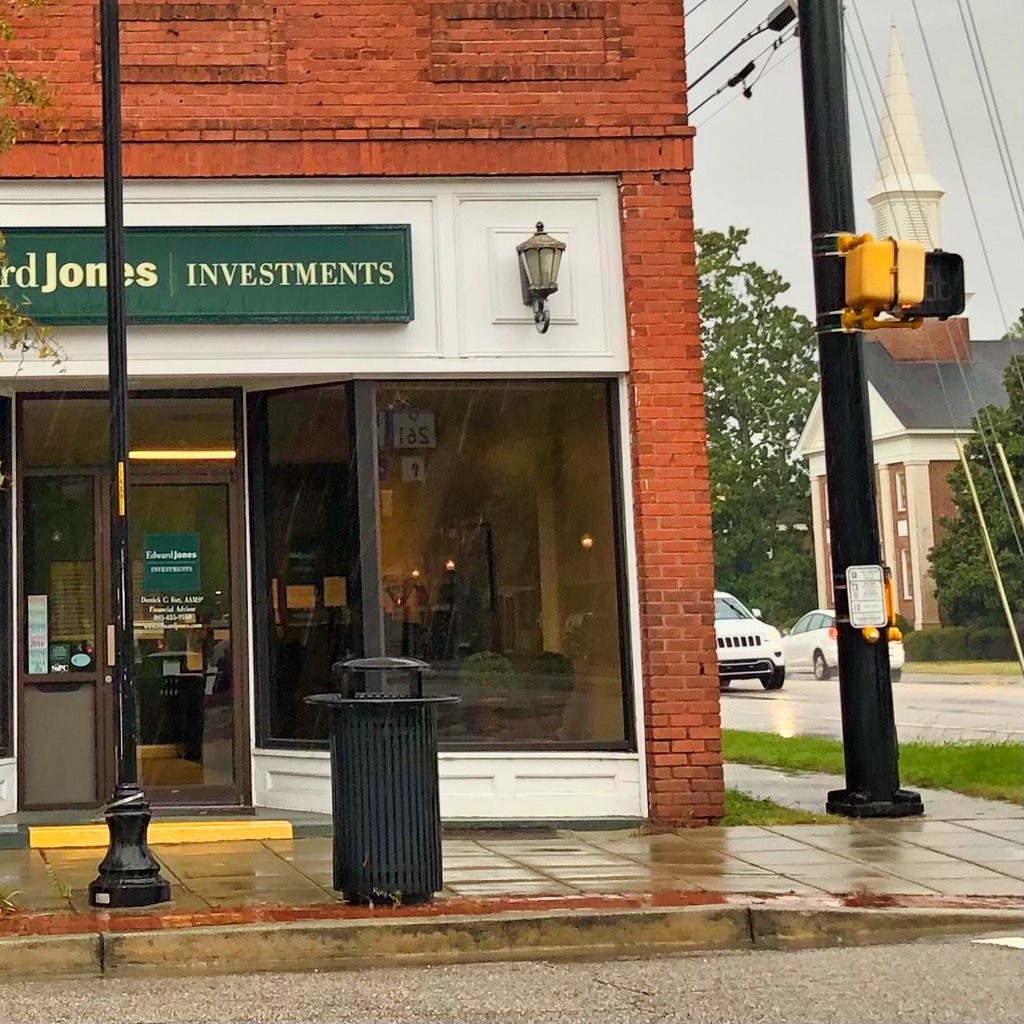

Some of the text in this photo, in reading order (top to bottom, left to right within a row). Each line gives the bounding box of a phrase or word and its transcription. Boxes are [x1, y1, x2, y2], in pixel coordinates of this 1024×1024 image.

[187, 261, 395, 287] INVESTMENTS
[149, 605, 196, 613] Financial Advisor
